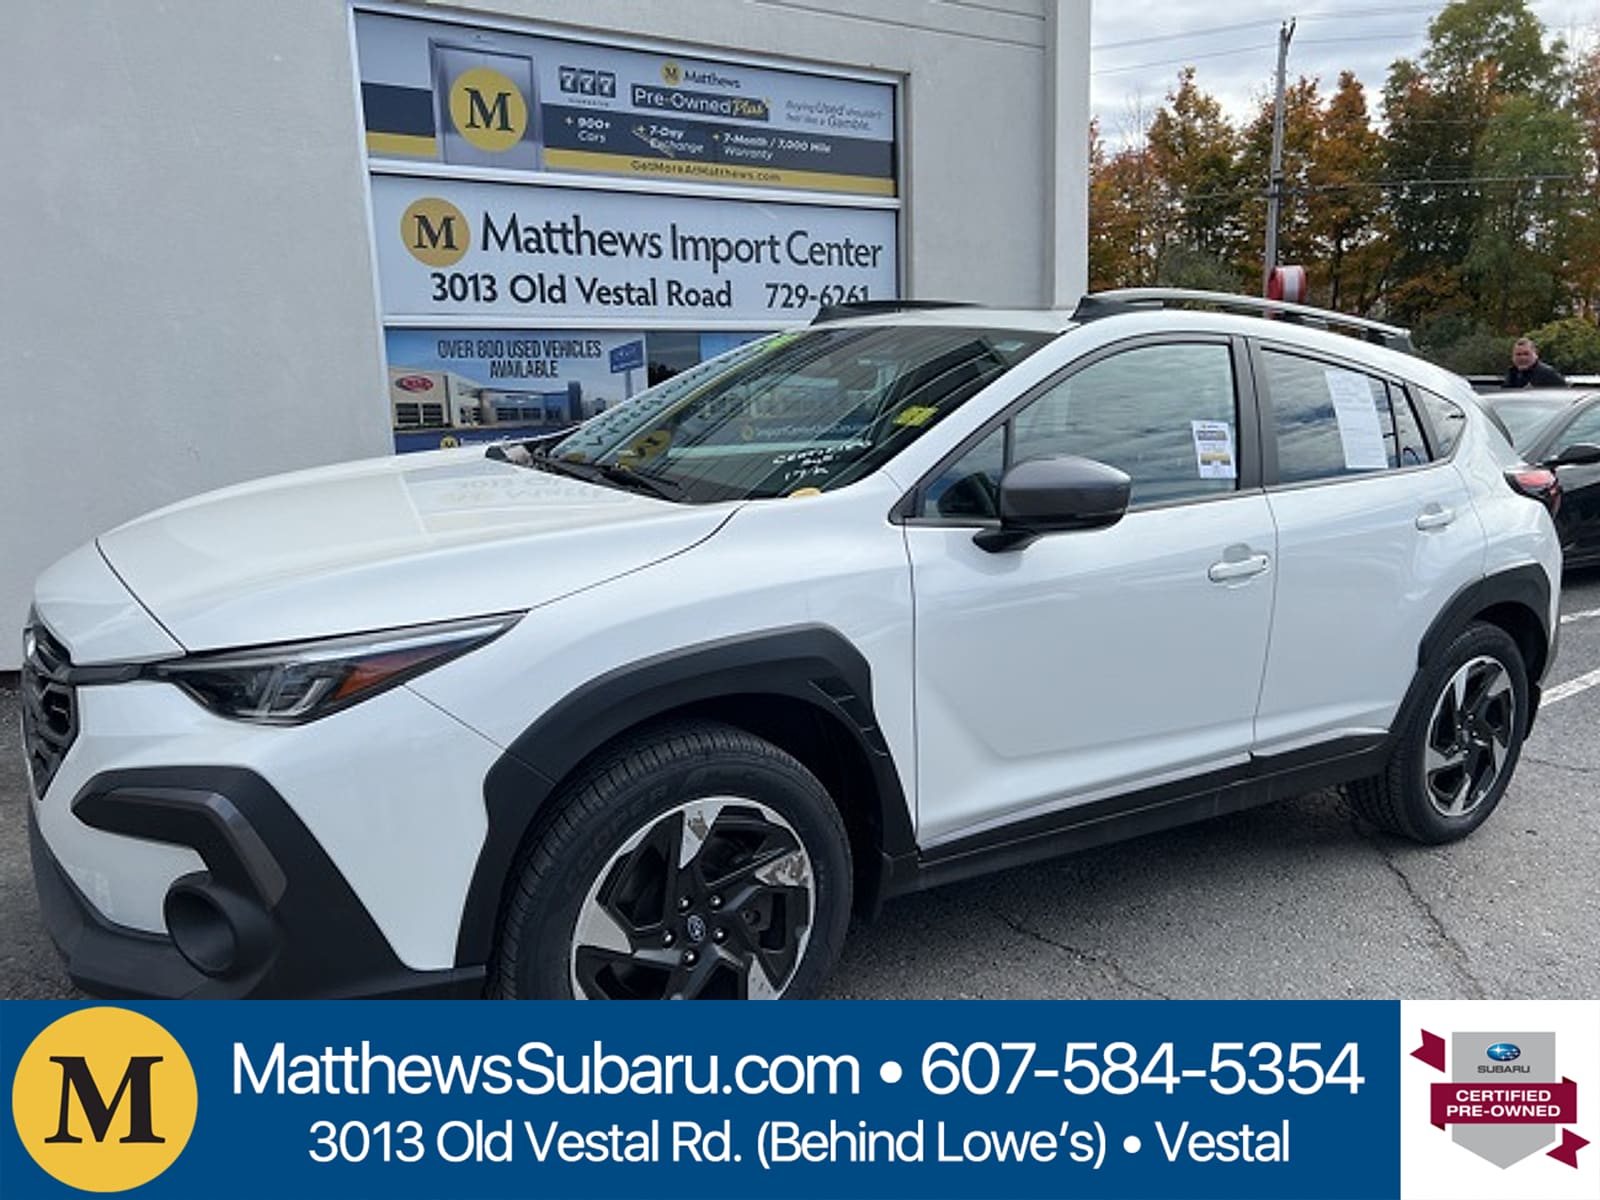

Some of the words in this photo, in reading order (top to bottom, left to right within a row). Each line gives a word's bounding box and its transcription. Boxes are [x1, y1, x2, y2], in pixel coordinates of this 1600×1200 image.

[684, 71, 741, 89] Matthews
[463, 87, 515, 133] M
[634, 87, 732, 115] Pre-Owned
[577, 130, 606, 143] Cars
[649, 125, 684, 138] 7-Day
[649, 138, 704, 153] Exchange
[630, 160, 781, 182] GetMoreAtMatthews.com
[413, 214, 458, 251] M
[480, 211, 662, 259] Matthews
[670, 222, 781, 274] Import
[786, 230, 883, 268] Center
[430, 272, 498, 302] 3013
[509, 273, 567, 304] Old
[575, 276, 658, 307] Vestal
[667, 279, 733, 308] Road
[437, 339, 475, 359] OVER
[478, 340, 506, 359] 800
[508, 340, 540, 359] USED
[544, 340, 601, 360] VEHICLES
[490, 360, 559, 379] AVAILABLE
